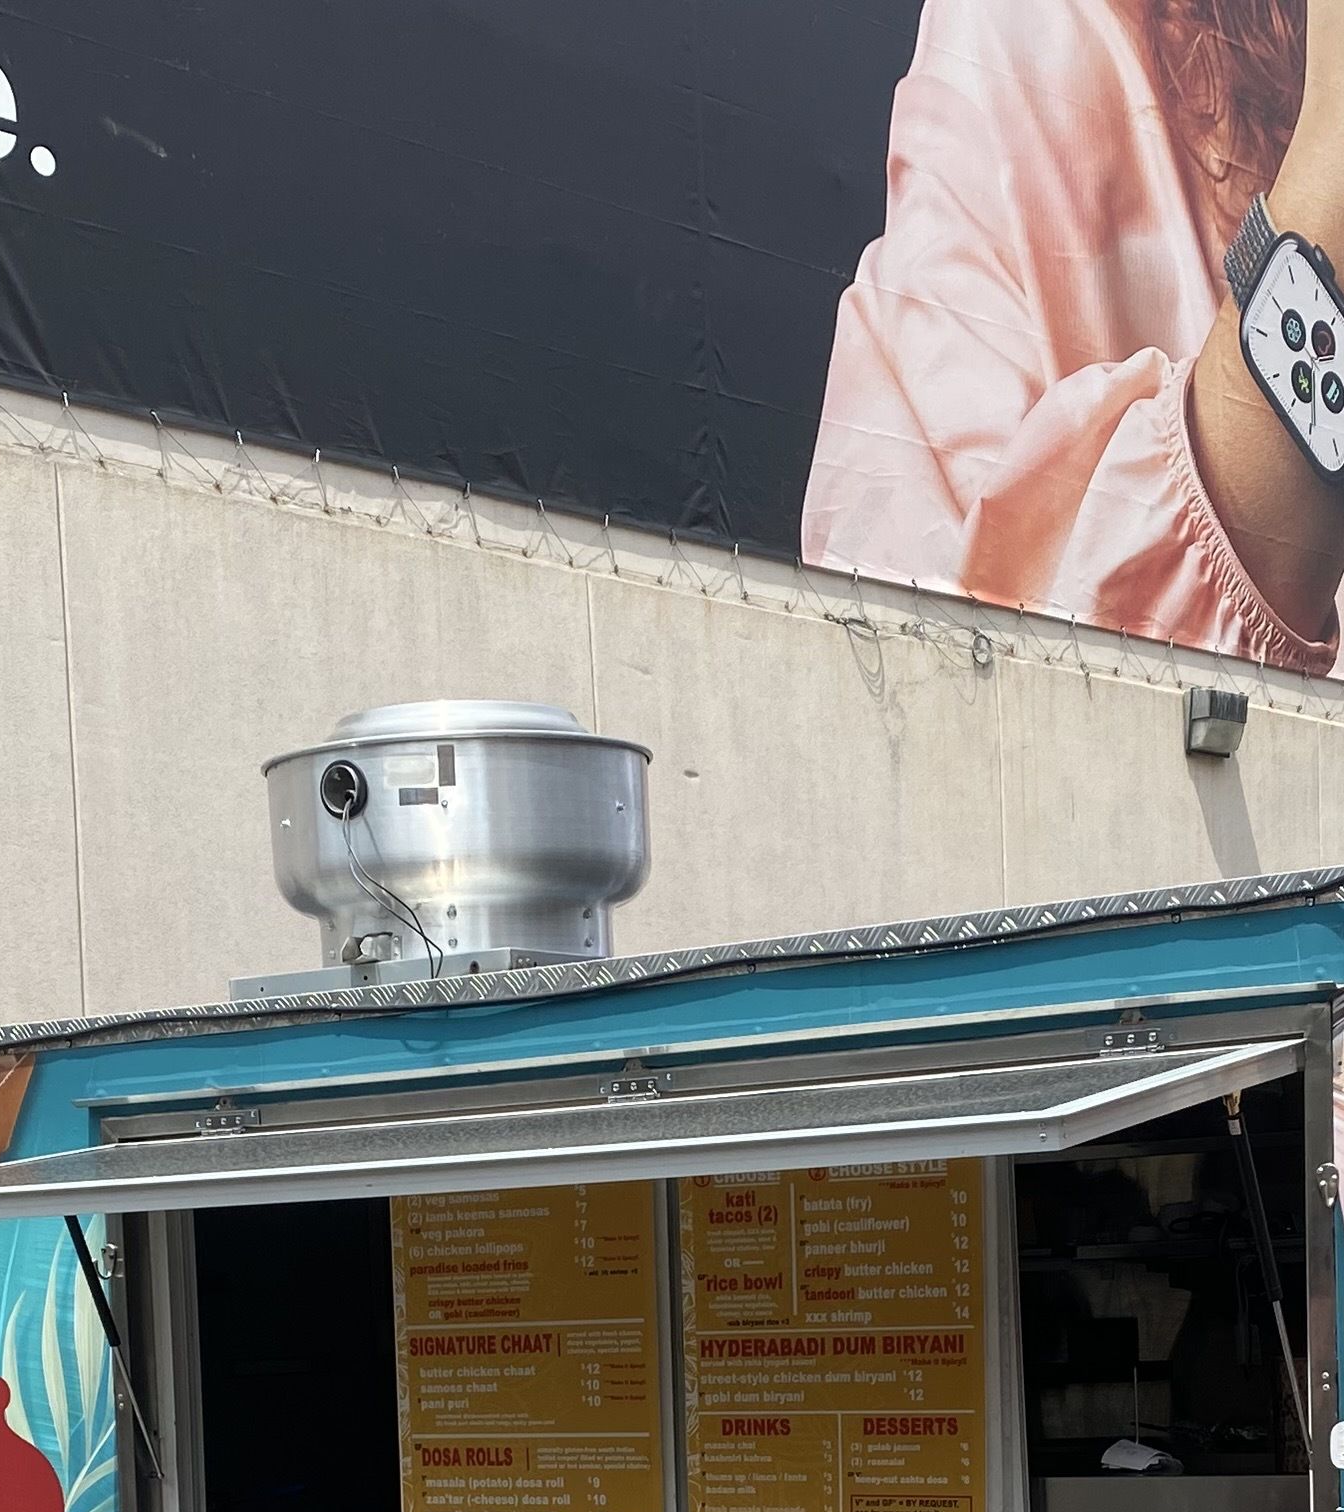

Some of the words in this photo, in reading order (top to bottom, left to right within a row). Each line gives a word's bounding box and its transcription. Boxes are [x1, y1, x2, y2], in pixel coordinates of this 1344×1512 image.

[828, 1163, 894, 1177] CHOOSE
[898, 1160, 948, 1174] STYLE
[425, 1195, 446, 1208] veg
[725, 1190, 756, 1208] kati
[804, 1198, 843, 1212] batata
[846, 1196, 872, 1212] (fry)
[425, 1212, 454, 1222] lamb
[456, 1210, 496, 1221] keema
[498, 1207, 550, 1218] samosas
[709, 1208, 753, 1224] tacos
[758, 1204, 778, 1226] (2)
[445, 1227, 484, 1242] pakora
[804, 1219, 830, 1237] gobi
[834, 1216, 910, 1236] (cauliflower)
[427, 1246, 472, 1257] chicken
[475, 1243, 524, 1256] lollipops
[806, 1243, 846, 1258] paneer
[850, 1240, 886, 1256] bhurji
[410, 1262, 458, 1277] paradise
[462, 1261, 500, 1272] loaded
[724, 1258, 741, 1268] OR
[804, 1264, 841, 1280] crispy
[844, 1263, 881, 1276] butter
[885, 1262, 933, 1276] chicken
[707, 1275, 738, 1292] rice
[744, 1272, 783, 1290] bowl
[806, 1287, 854, 1301] tandoori
[858, 1285, 895, 1300] butter
[899, 1284, 947, 1298] chicken
[806, 1312, 828, 1324] xxx
[830, 1309, 872, 1324] shrimp
[410, 1335, 496, 1356] SIGNATURE
[501, 1334, 552, 1354] CHAAT
[701, 1338, 826, 1358] HYDERABADI
[832, 1336, 876, 1356] DUM
[882, 1334, 964, 1354] BIRYANI
[420, 1368, 454, 1378] butter
[456, 1366, 500, 1377] chicken
[504, 1365, 536, 1376] chaat
[701, 1372, 770, 1386] street-style
[773, 1372, 822, 1383] chicken
[824, 1370, 851, 1382] dum
[854, 1370, 896, 1385] biryani
[420, 1383, 463, 1394] samosa
[466, 1382, 498, 1393] chaat
[448, 1398, 469, 1410] puri
[705, 1392, 730, 1406] gobi
[734, 1391, 760, 1402] dum
[763, 1390, 804, 1404] biryani
[722, 1418, 791, 1436] DRINKS
[864, 1417, 958, 1436] DESSERTS
[422, 1447, 462, 1466] DOSA
[466, 1447, 512, 1466] ROLLS
[426, 1477, 466, 1488] masala
[469, 1477, 512, 1490] (potato)
[516, 1477, 542, 1488] dosa
[546, 1477, 564, 1488] roll
[522, 1494, 549, 1504] dosa
[552, 1494, 570, 1504] roll
